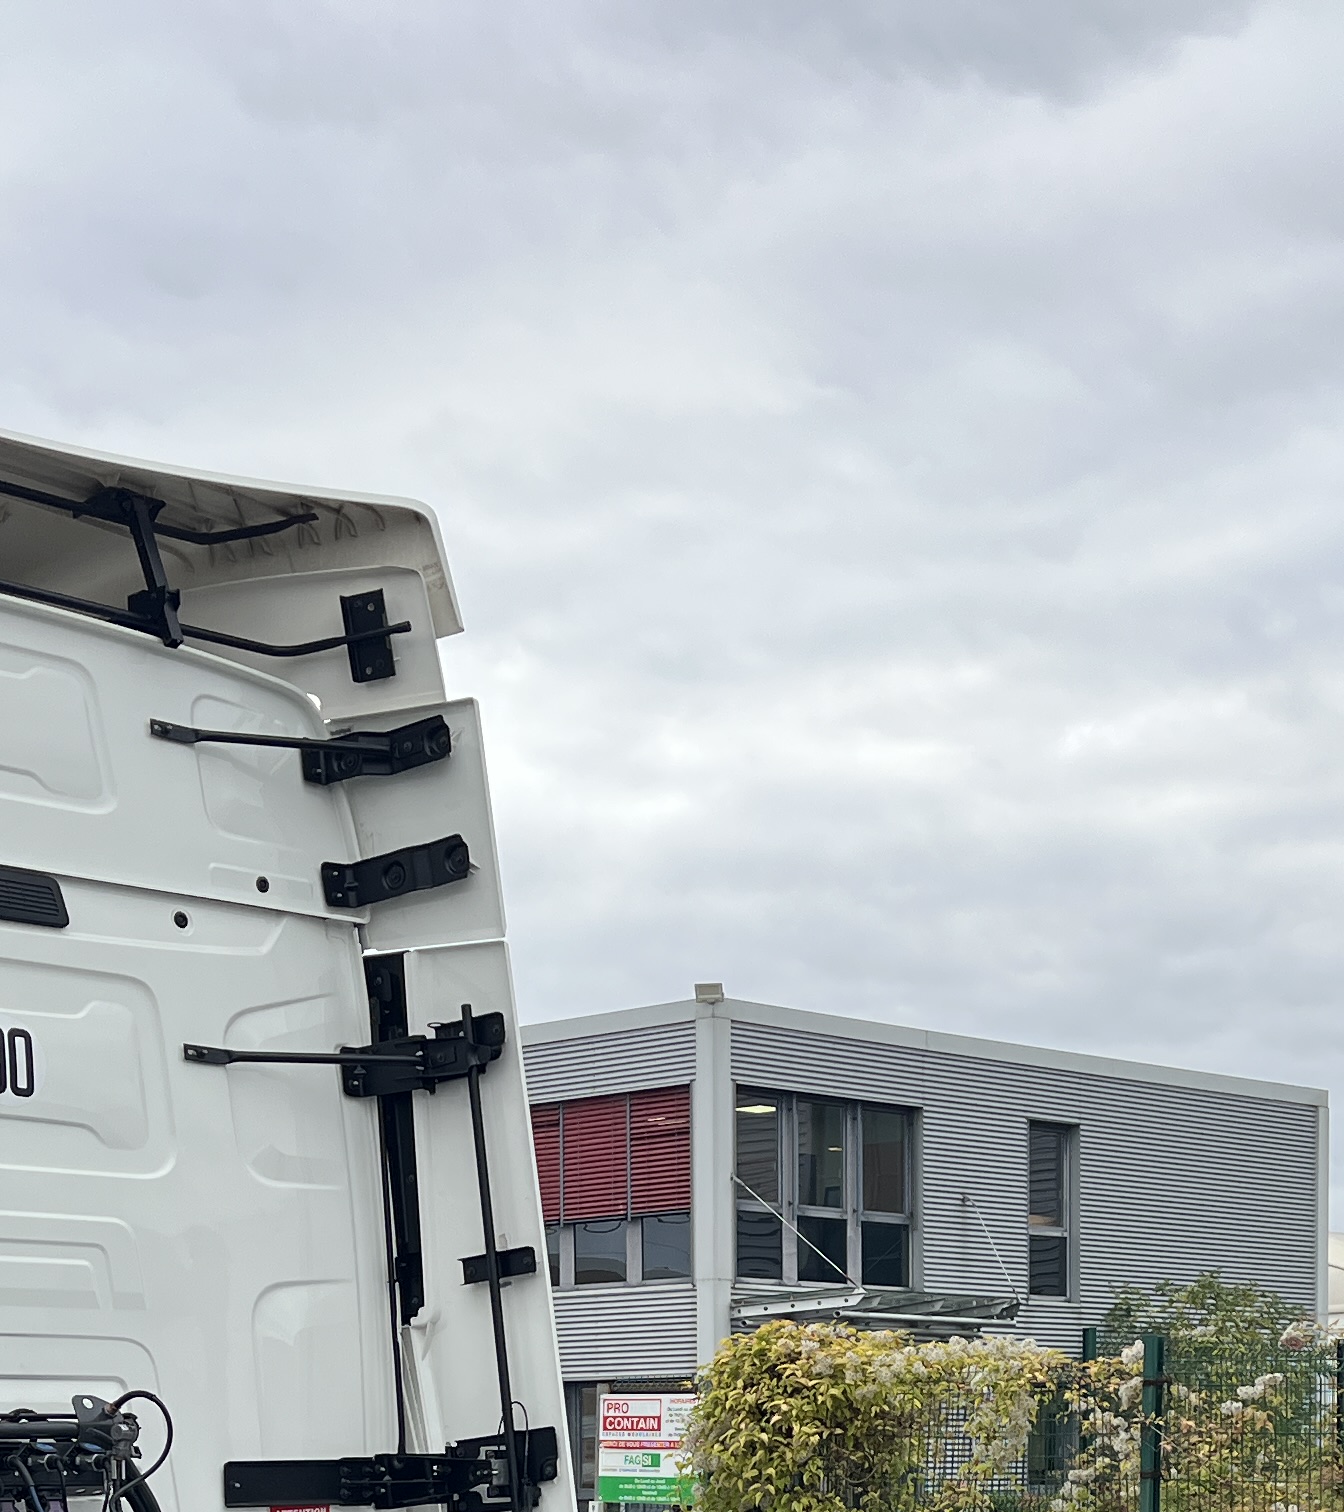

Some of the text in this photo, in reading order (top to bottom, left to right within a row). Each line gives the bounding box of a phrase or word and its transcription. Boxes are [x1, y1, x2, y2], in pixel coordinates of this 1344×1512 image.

[606, 1402, 630, 1414] PRO
[606, 1417, 659, 1430] CONTAIN
[623, 1454, 652, 1466] FAGSI
